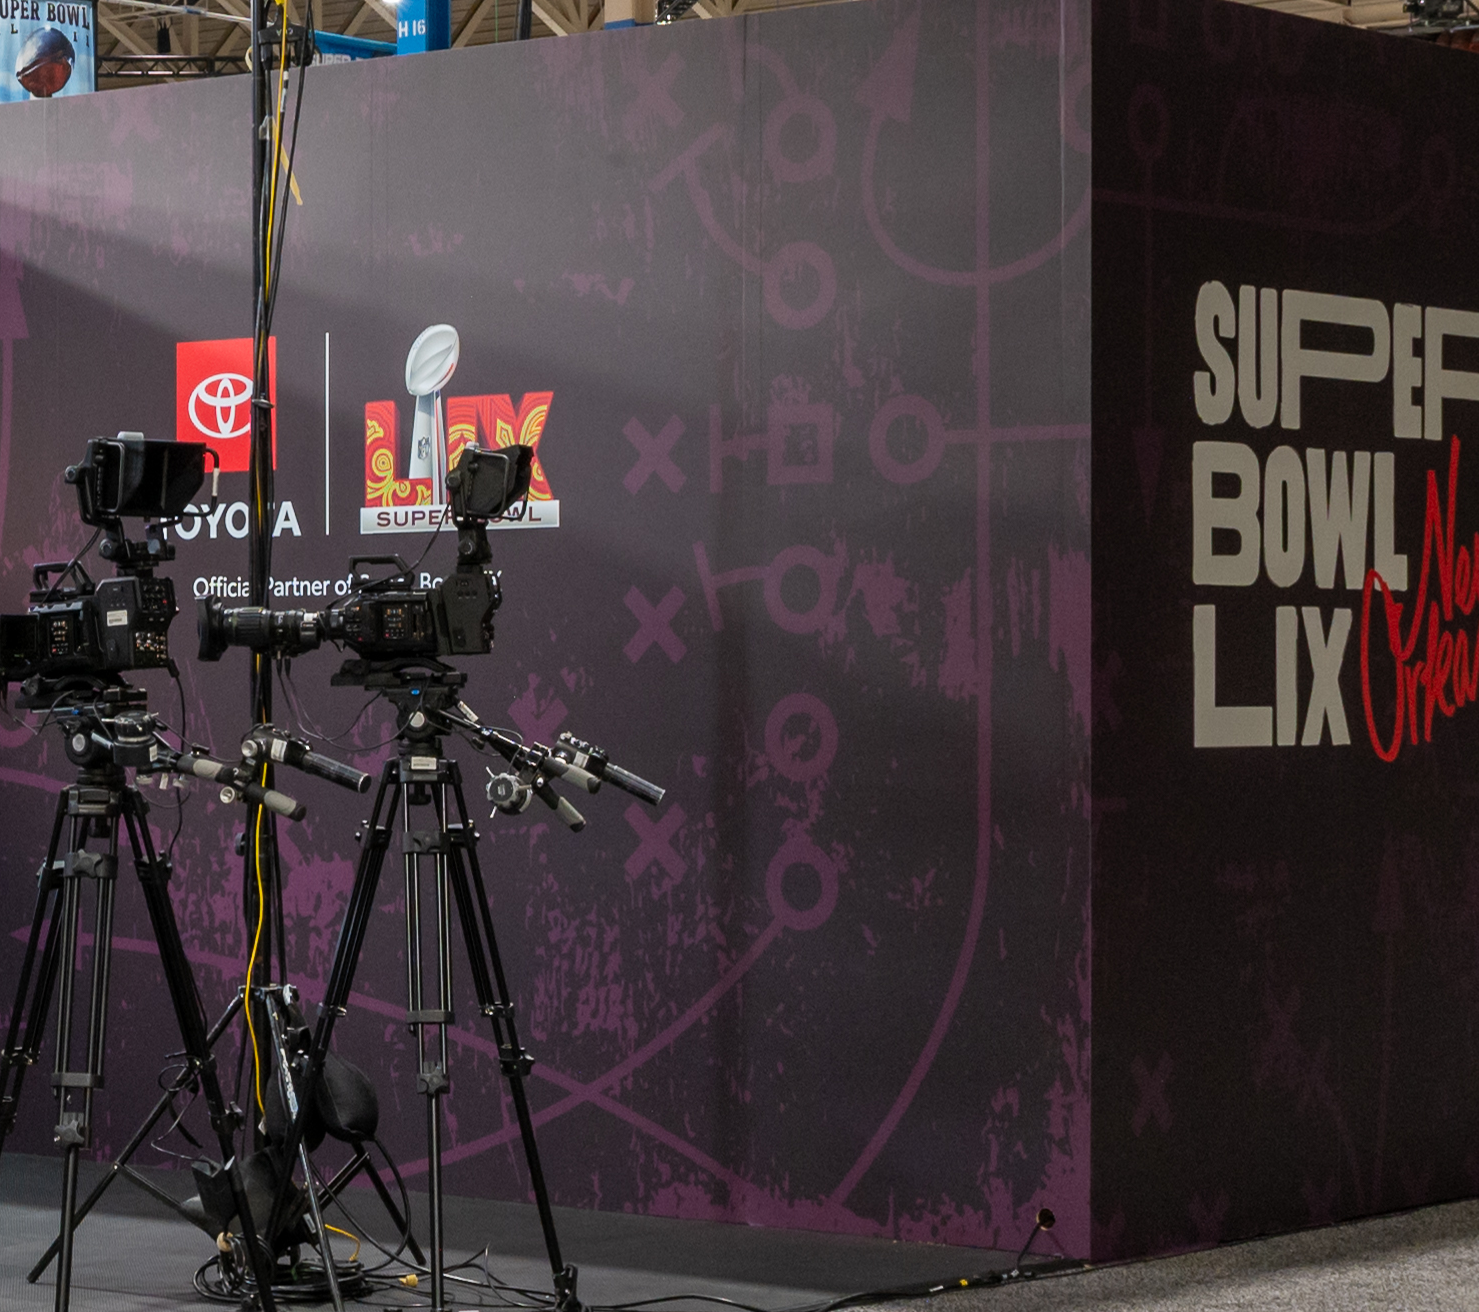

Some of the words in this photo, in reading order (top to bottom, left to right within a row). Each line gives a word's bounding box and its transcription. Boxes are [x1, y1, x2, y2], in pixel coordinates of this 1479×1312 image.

[46, 2, 91, 31] BOWL
[1191, 440, 1408, 592] BOWL
[193, 575, 250, 598] Officia
[1192, 603, 1353, 749] LIX
